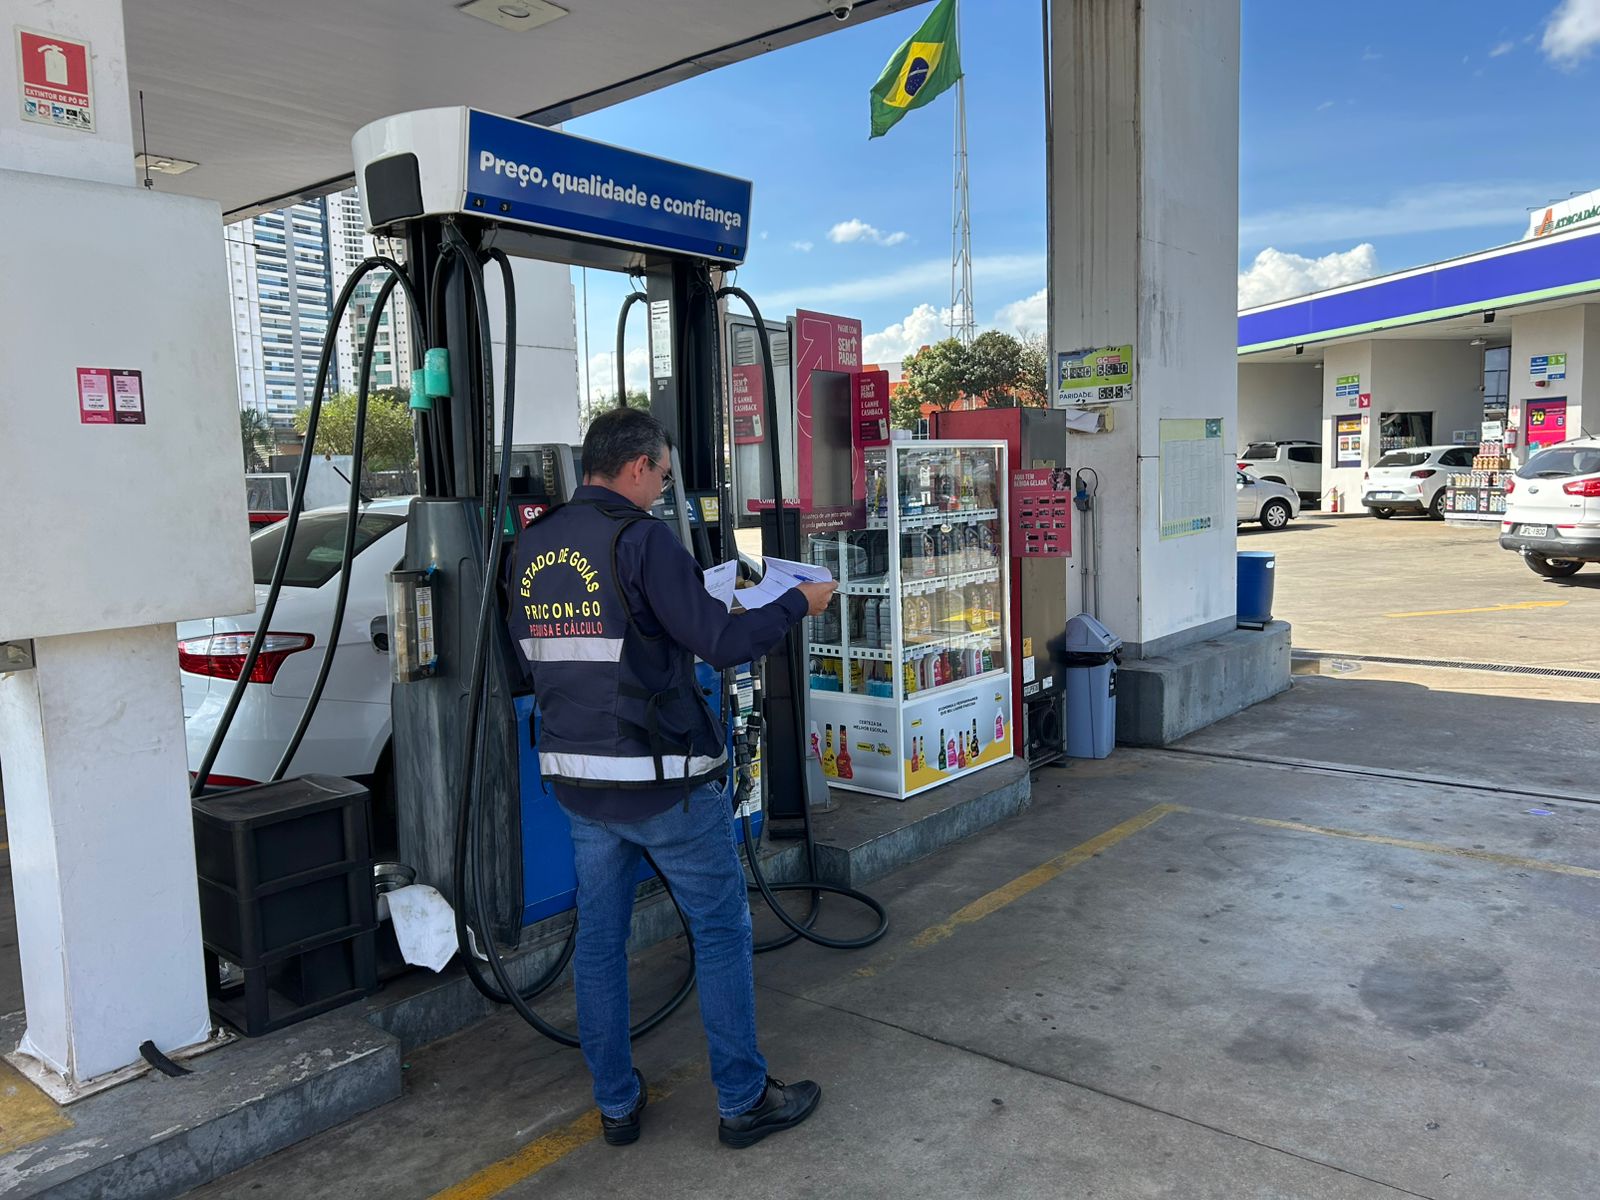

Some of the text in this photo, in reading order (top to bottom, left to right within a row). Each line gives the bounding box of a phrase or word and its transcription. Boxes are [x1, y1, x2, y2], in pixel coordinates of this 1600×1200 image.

[25, 87, 88, 106] EXTINTOR DE PÓ BC
[480, 150, 741, 231] Preço, qualidade e confiança
[838, 337, 851, 352] SEM
[838, 352, 857, 367] PARAR
[1062, 360, 1072, 368] EC
[734, 404, 757, 412] CASHBACK
[861, 408, 884, 417] CASHBACK
[1014, 480, 1029, 488] BEBIDA
[520, 547, 600, 598] ESTADO DE GOIÁS
[555, 623, 561, 636] E
[563, 619, 603, 636] CÁLCULO
[859, 719, 877, 727] CERTEZA
